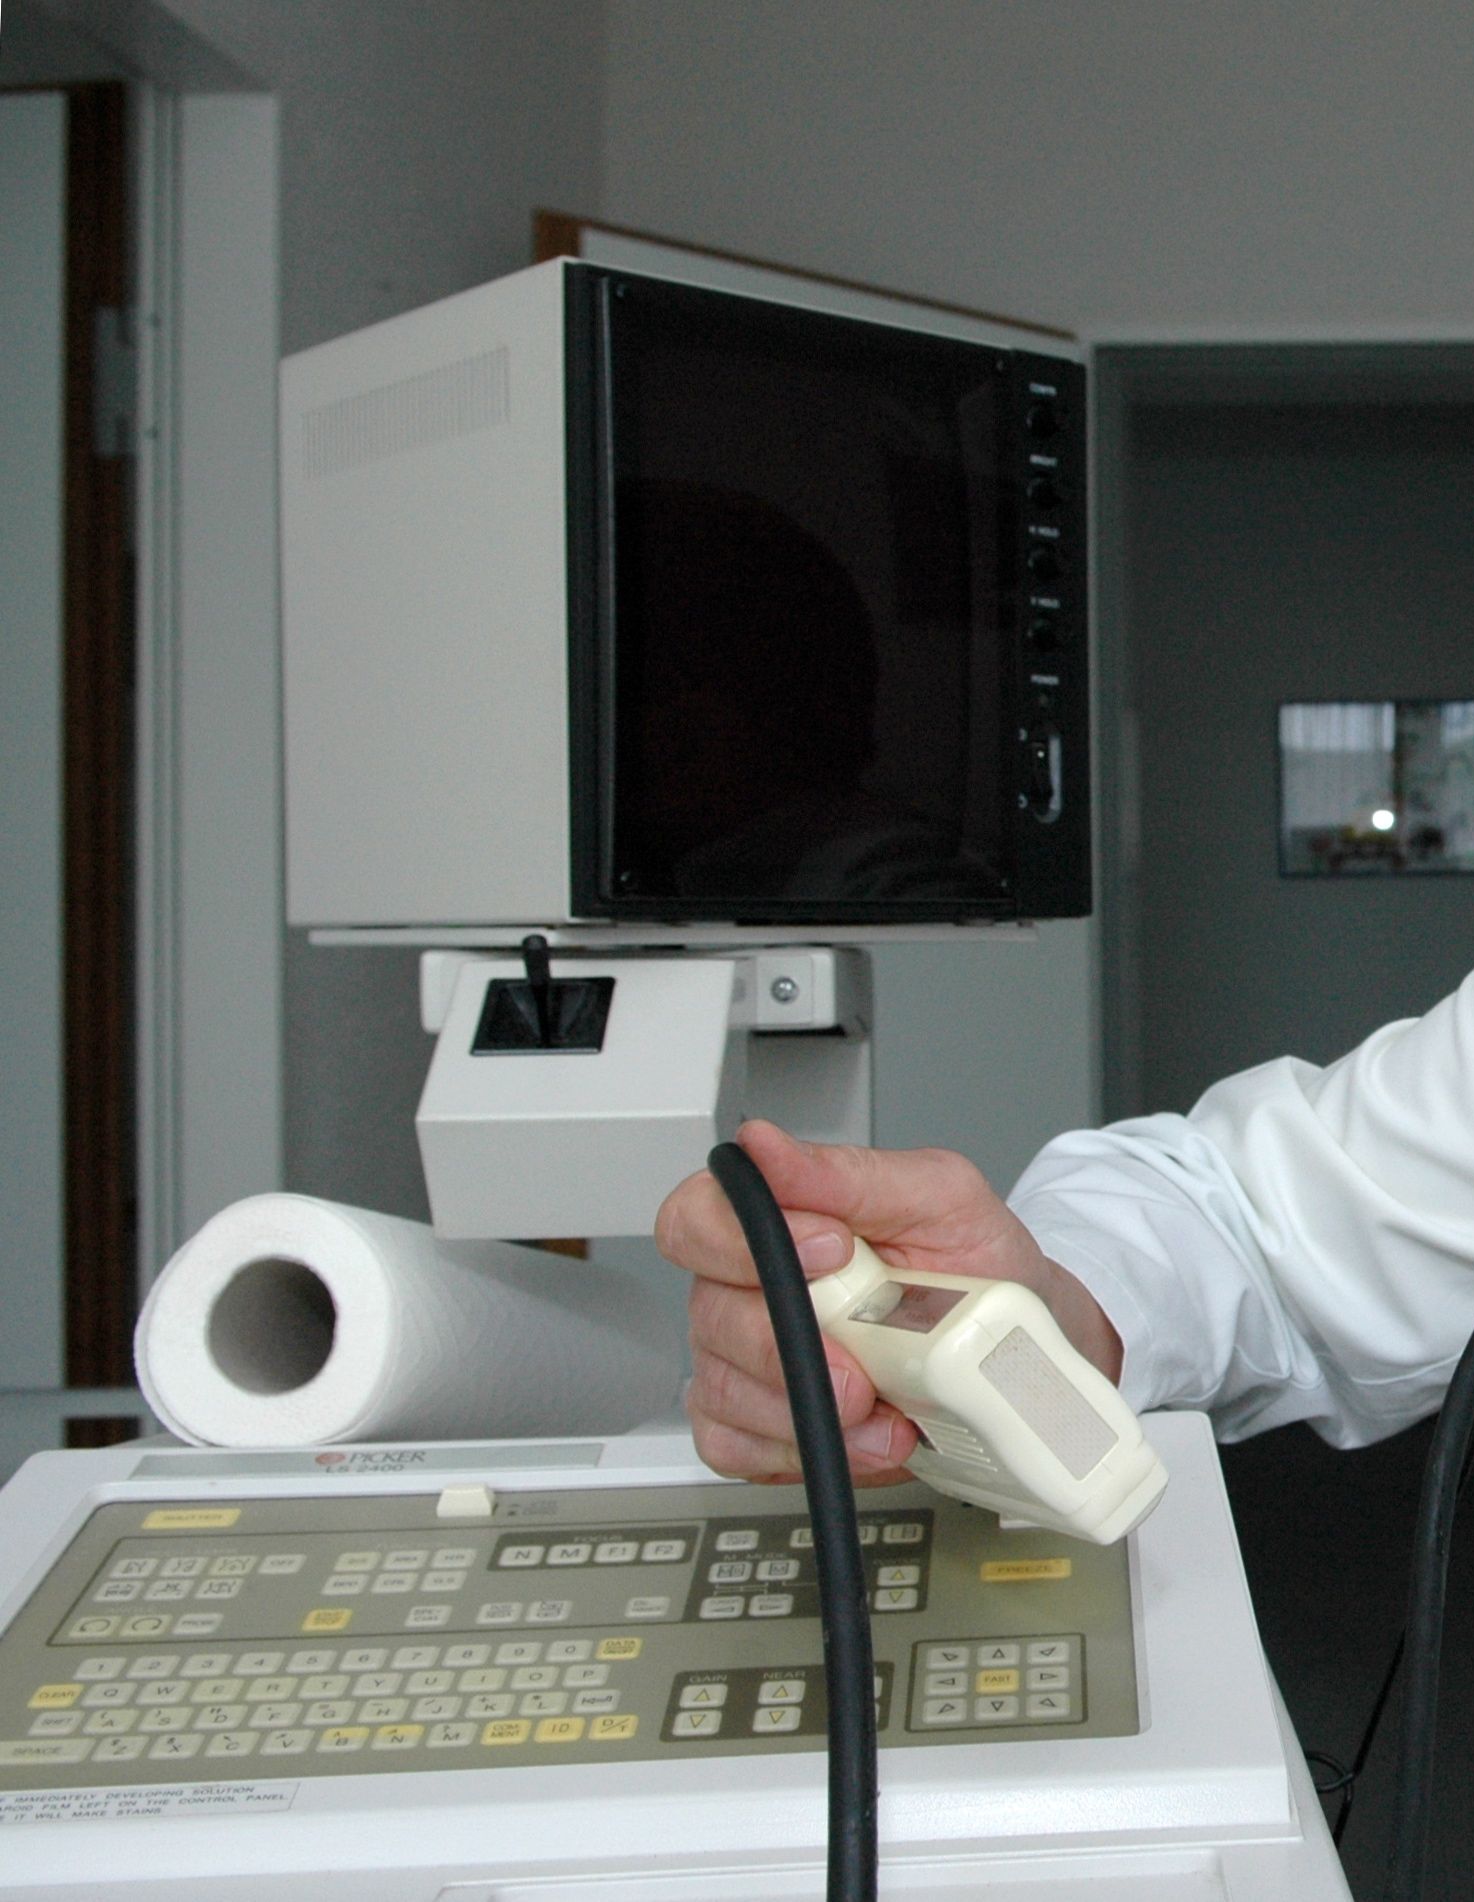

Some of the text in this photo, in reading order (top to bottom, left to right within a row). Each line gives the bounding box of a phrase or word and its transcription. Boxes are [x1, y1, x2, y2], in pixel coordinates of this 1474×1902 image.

[349, 1451, 426, 1463] PICKER
[360, 1464, 404, 1473] 2400
[574, 1535, 623, 1543] FOCUS
[560, 1549, 580, 1558] M
[608, 1547, 627, 1556] F1
[653, 1545, 675, 1555] F2
[515, 1551, 530, 1560] N
[148, 1661, 161, 1670] 2
[529, 1672, 543, 1681] O
[689, 1673, 729, 1683] GAIN
[763, 1670, 807, 1680] NEAR
[984, 1674, 1011, 1683] FAST
[38, 1690, 76, 1699] CLEAR
[103, 1688, 119, 1698] Q
[157, 1686, 175, 1695] W
[41, 1717, 73, 1726] SHIFT
[13, 1746, 62, 1755] SPACE
[15, 1793, 97, 1803] IMMEDIATELY
[106, 1789, 183, 1799] DEVELOPING
[192, 1786, 256, 1796] SOLUTION
[80, 1801, 109, 1809] LEFT
[118, 1799, 138, 1807] ON
[147, 1798, 170, 1806] THE
[179, 1795, 237, 1804] CONTROL
[35, 1812, 61, 1820] WILL
[72, 1809, 107, 1818] MAKE
[116, 1806, 162, 1816] STAINS
